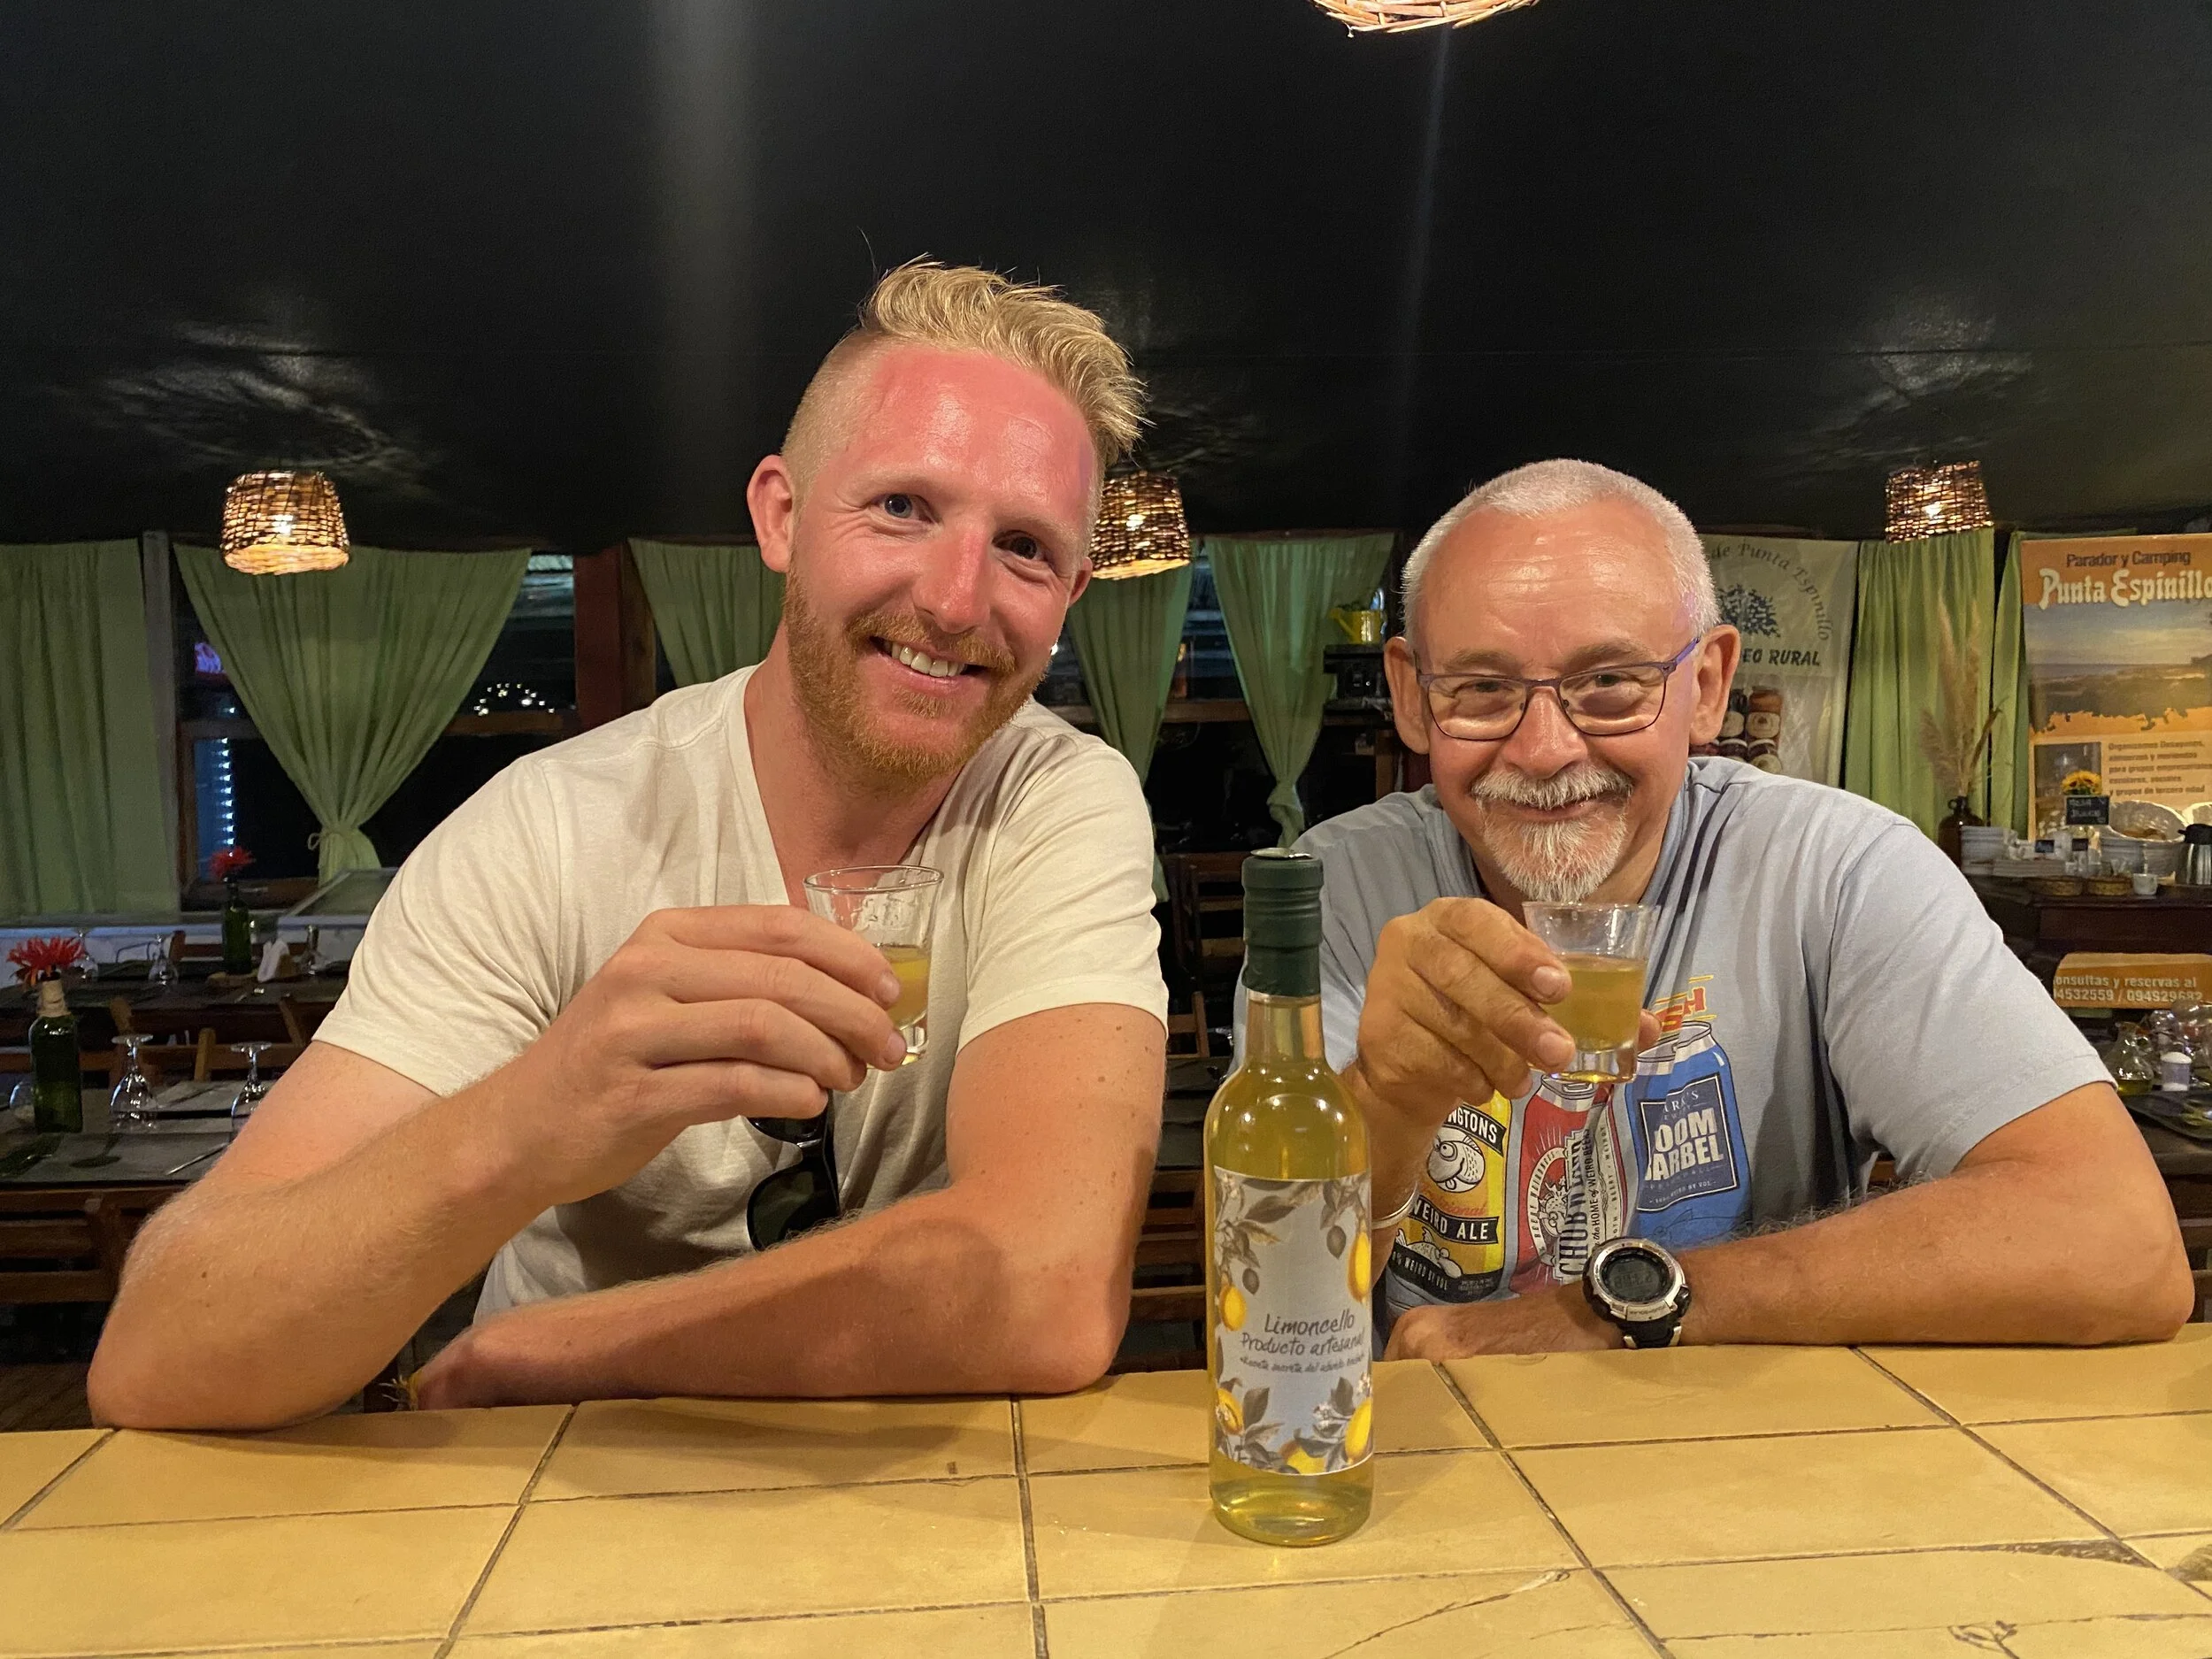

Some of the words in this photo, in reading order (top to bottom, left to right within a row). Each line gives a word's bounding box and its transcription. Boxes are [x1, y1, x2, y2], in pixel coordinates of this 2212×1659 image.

[1738, 540, 1790, 570] Punta
[2066, 552, 2116, 567] Parador
[2121, 555, 2129, 567] y
[2132, 550, 2191, 565] Camping
[2039, 568, 2107, 610] Punta
[2110, 568, 2212, 607] Espinillo
[1768, 649, 1820, 665] RURAL
[2054, 975, 2108, 987] onsultas
[2114, 978, 2120, 989] y
[2124, 977, 2179, 988] reservas
[2184, 977, 2197, 987] al
[2054, 987, 2114, 1001] 4532559
[1654, 1108, 1717, 1152] OOM
[1585, 1157, 1596, 1187] WEIRD
[1591, 1199, 1600, 1226] HOME
[1456, 1222, 1488, 1240] ALE
[1264, 1309, 1355, 1336] Limoncello
[1240, 1332, 1305, 1356] Producto
[1310, 1327, 1364, 1356] artesanal
